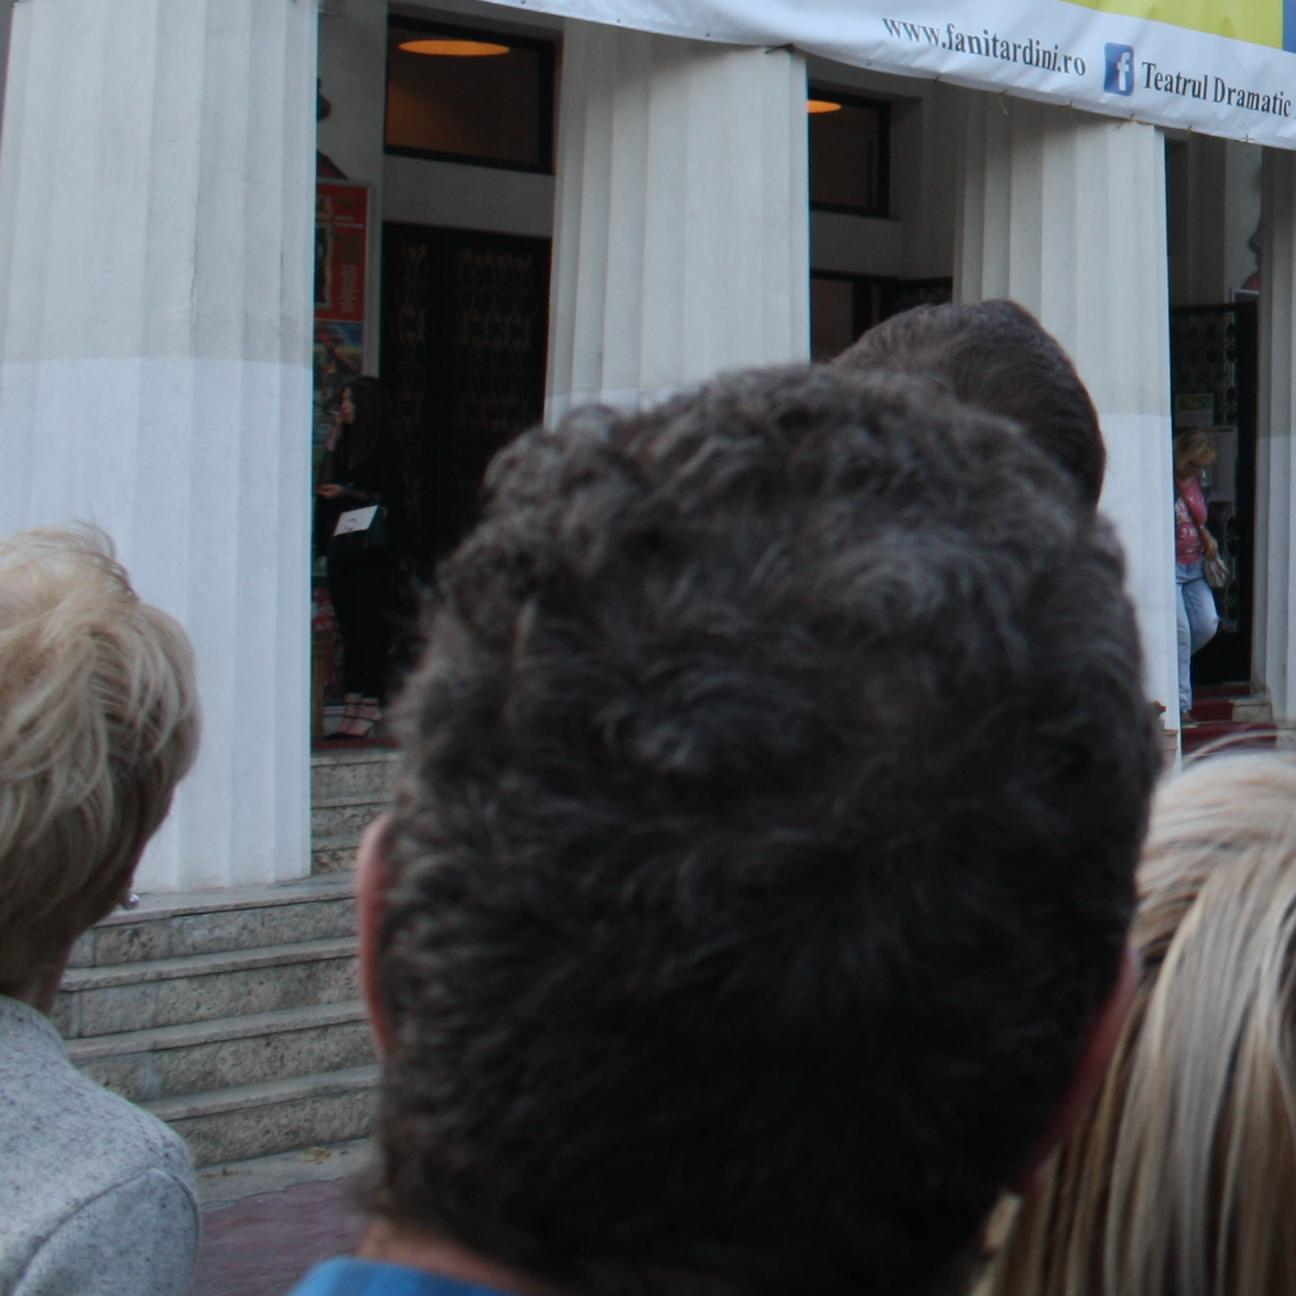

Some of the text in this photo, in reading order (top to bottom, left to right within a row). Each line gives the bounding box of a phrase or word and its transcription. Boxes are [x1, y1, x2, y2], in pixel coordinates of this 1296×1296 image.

[881, 17, 1087, 77] www.fanitardini.ro
[1141, 61, 1209, 101] Teatrul
[1213, 75, 1292, 119] Dramatic
